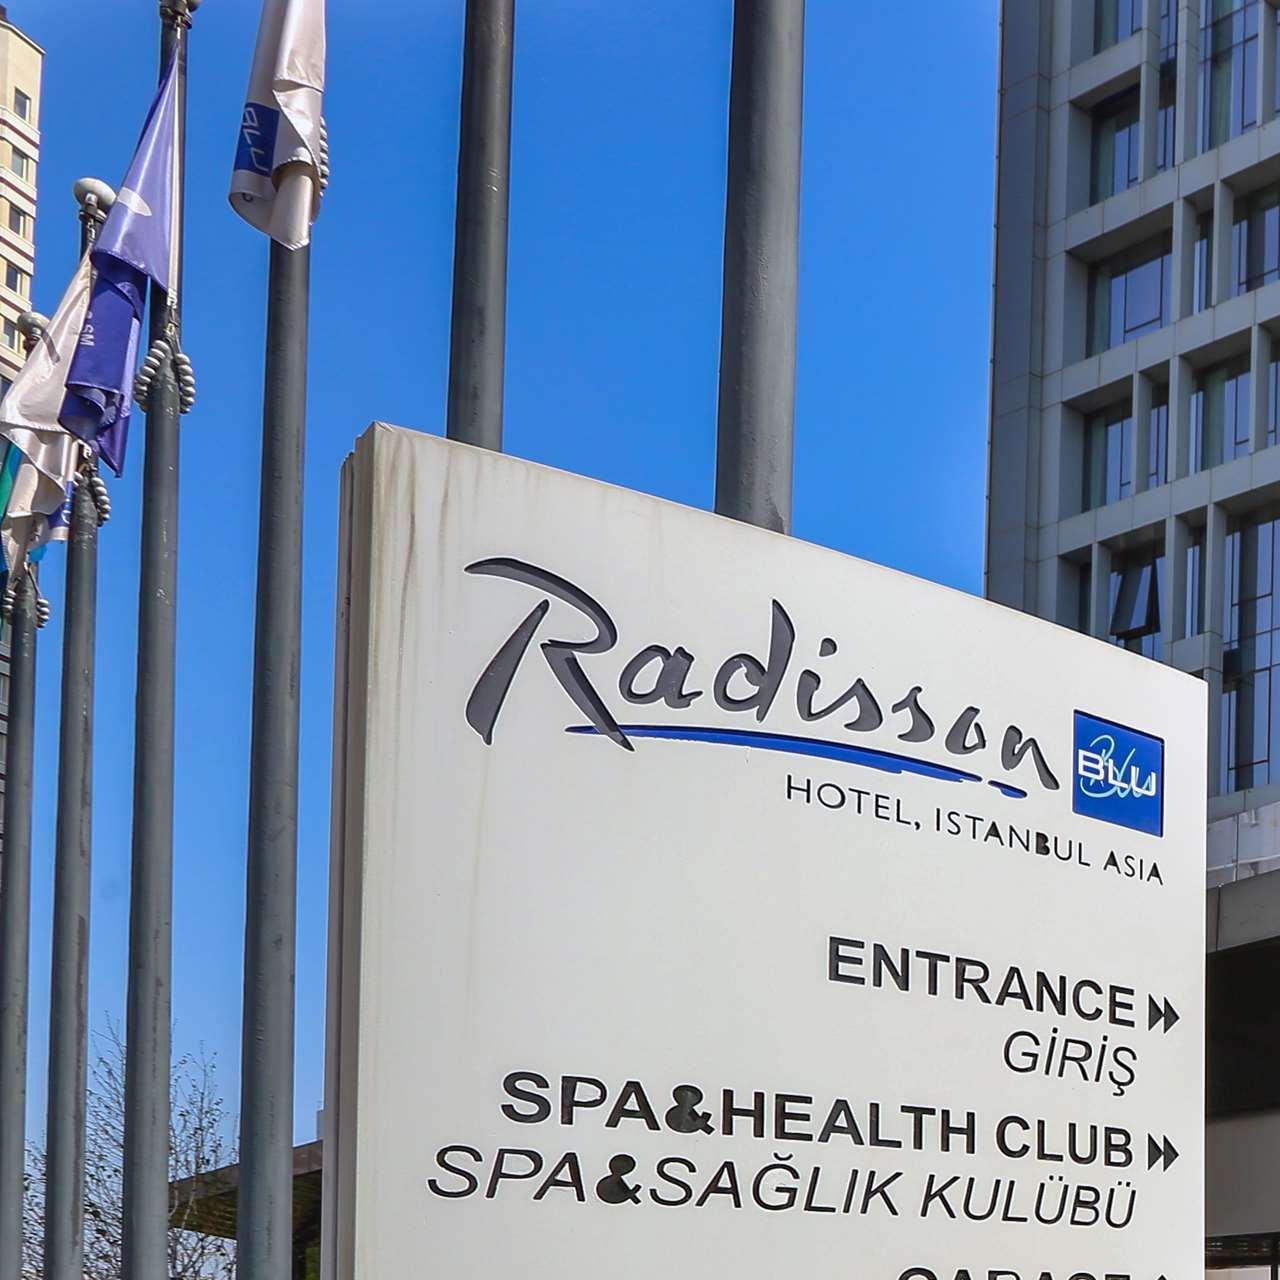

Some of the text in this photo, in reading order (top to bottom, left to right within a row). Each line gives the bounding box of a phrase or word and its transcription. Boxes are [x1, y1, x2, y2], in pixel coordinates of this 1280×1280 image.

[464, 556, 1061, 791] Radisson
[1077, 748, 1157, 797] BLU
[786, 774, 1164, 886] HOTEL, ISTANBUL ASIA
[828, 935, 1137, 1029] ENTRANCE
[1003, 1029, 1139, 1097] GİRİŞ
[500, 1071, 1133, 1168] SPA&HEALTH CLUB
[427, 1144, 1138, 1230] SPA&SAĞLIK KULÜBÜ
